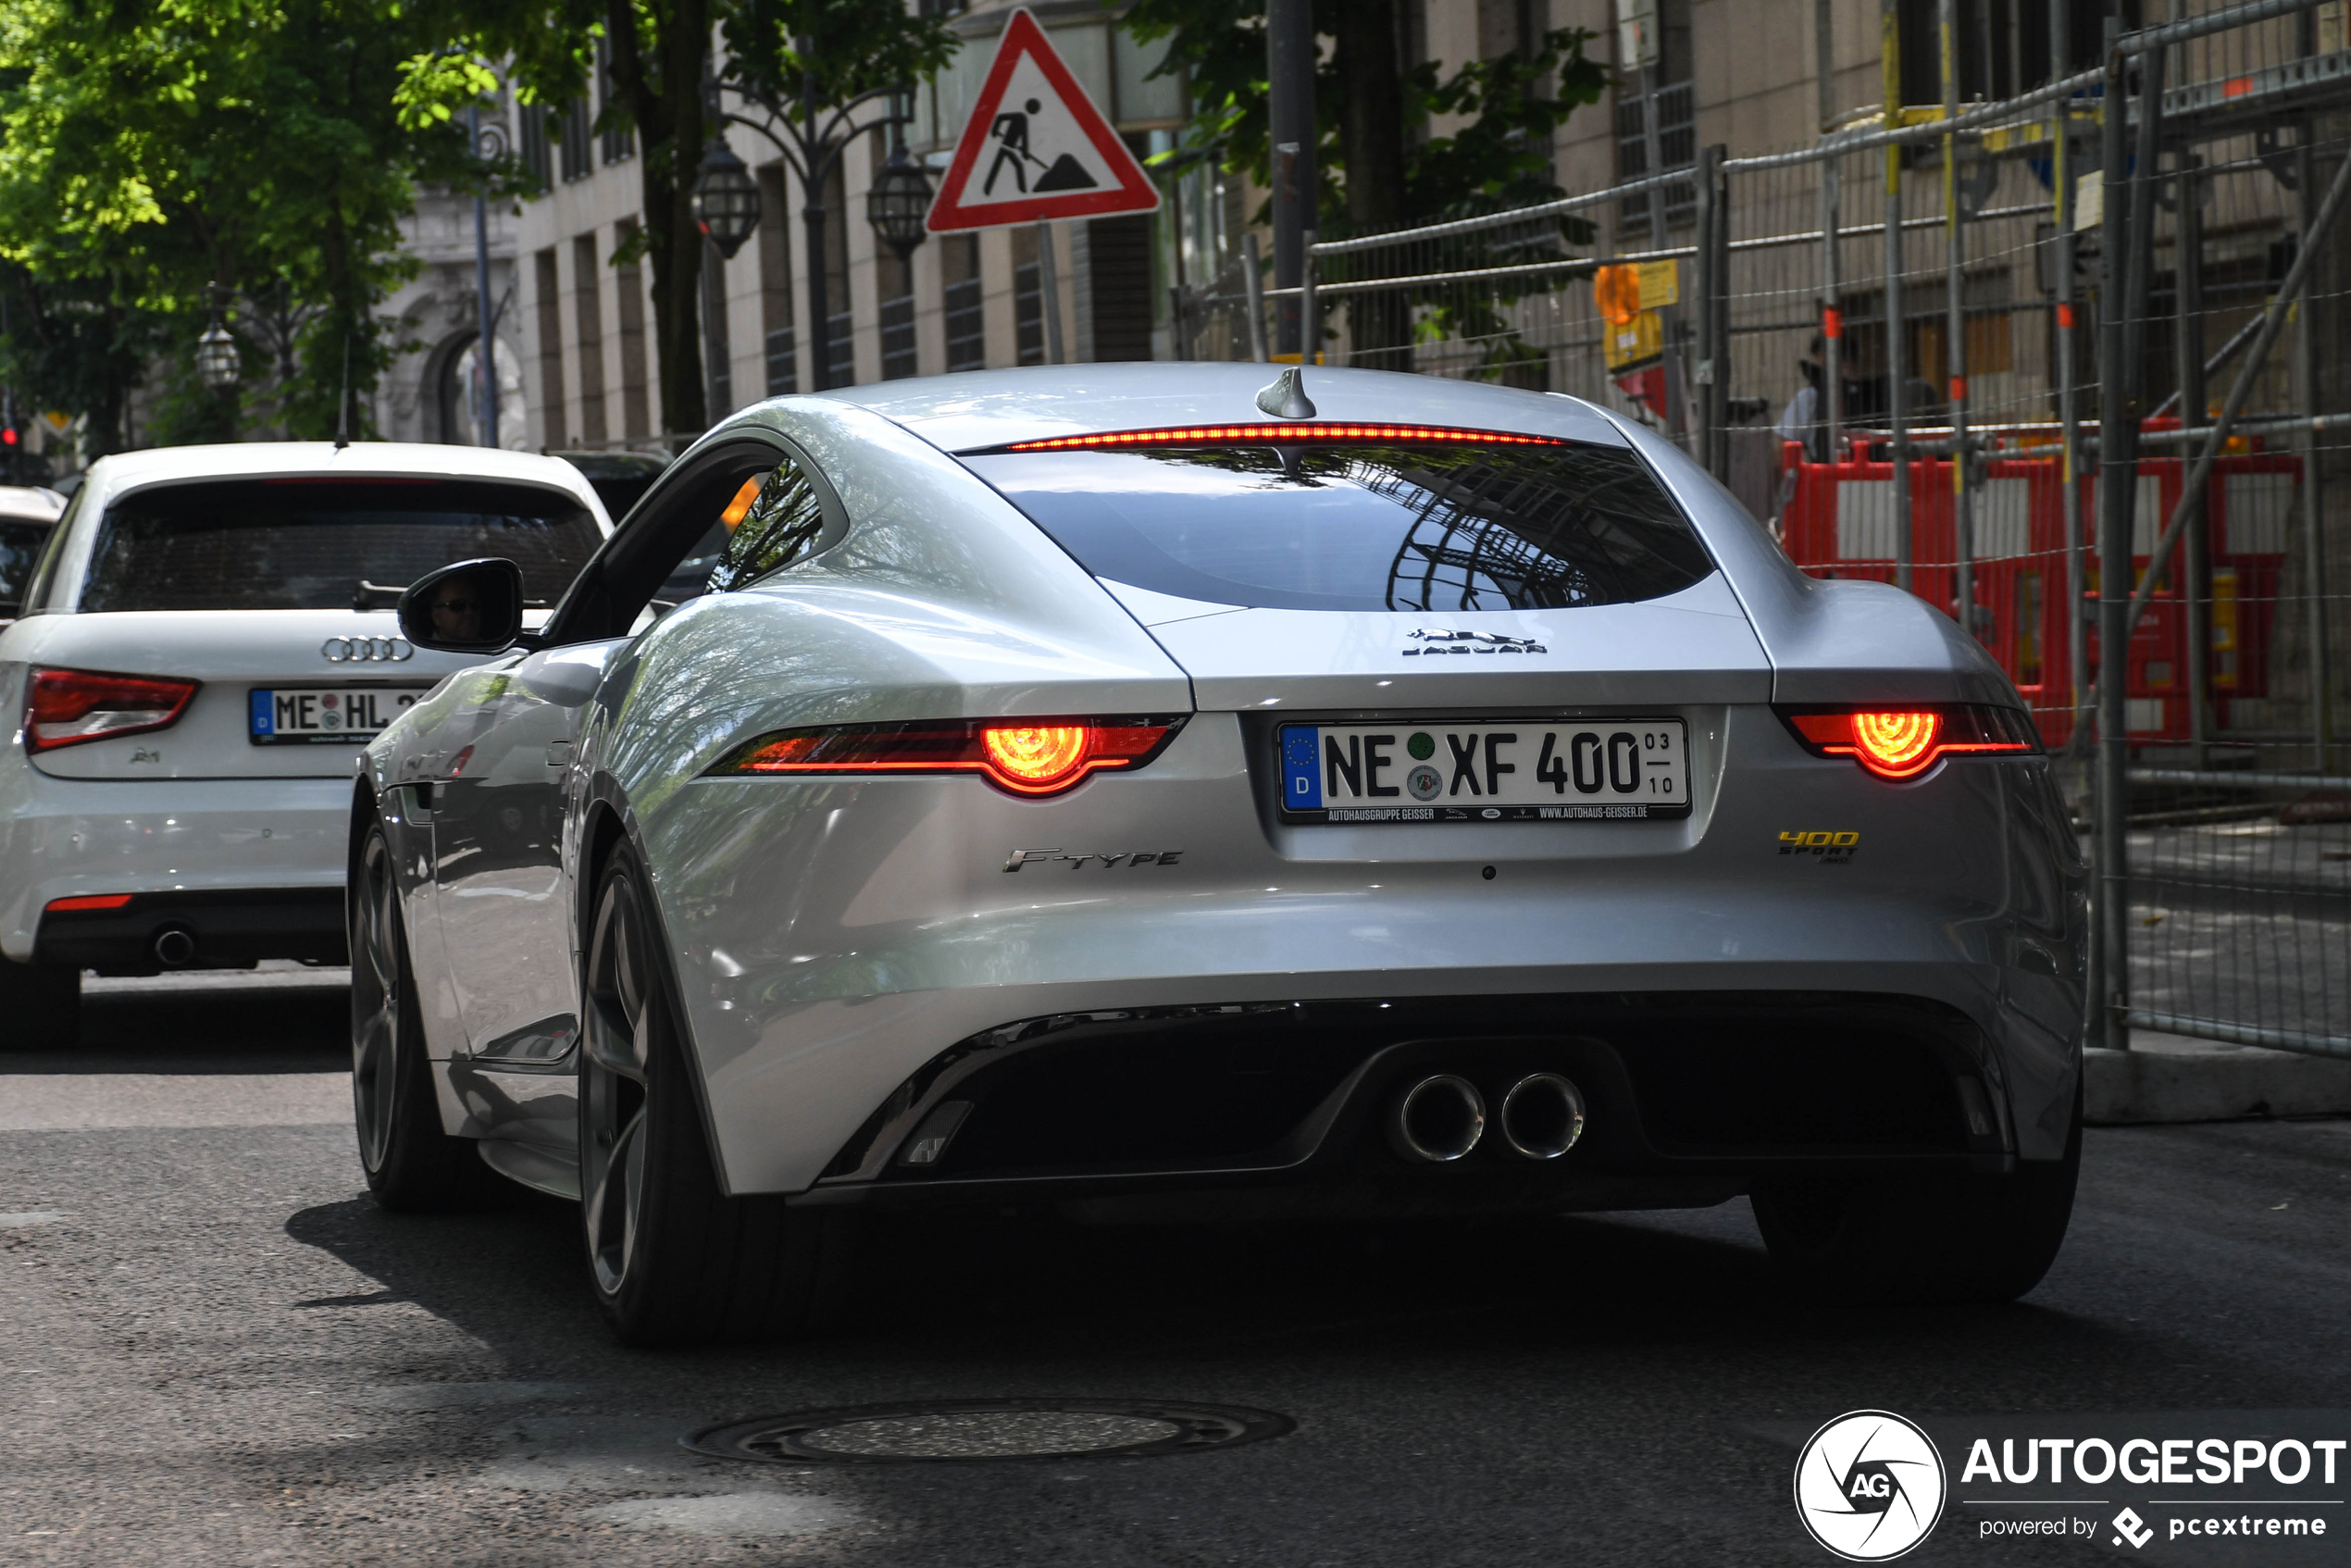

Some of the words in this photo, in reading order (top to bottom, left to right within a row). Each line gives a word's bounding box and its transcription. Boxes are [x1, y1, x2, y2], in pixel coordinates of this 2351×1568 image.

[1402, 644, 1548, 656] JAGUAR
[276, 695, 319, 729] ME
[346, 694, 389, 728] HL
[1644, 733, 1670, 750] 03
[1325, 735, 1400, 797] NE
[1447, 733, 1518, 796] XF
[1536, 732, 1641, 794] 400
[1296, 777, 1310, 794] D
[1648, 778, 1673, 794] 10
[1328, 808, 1400, 821] AUTOHAUSGRUPPE
[1401, 808, 1435, 820] GEISSER
[1539, 806, 1648, 819] WWW.AUTOHAUS-GEISSER.DE
[1779, 831, 1860, 846] 400
[1777, 846, 1859, 856] SPORT
[1002, 848, 1184, 873] F-TYPE
